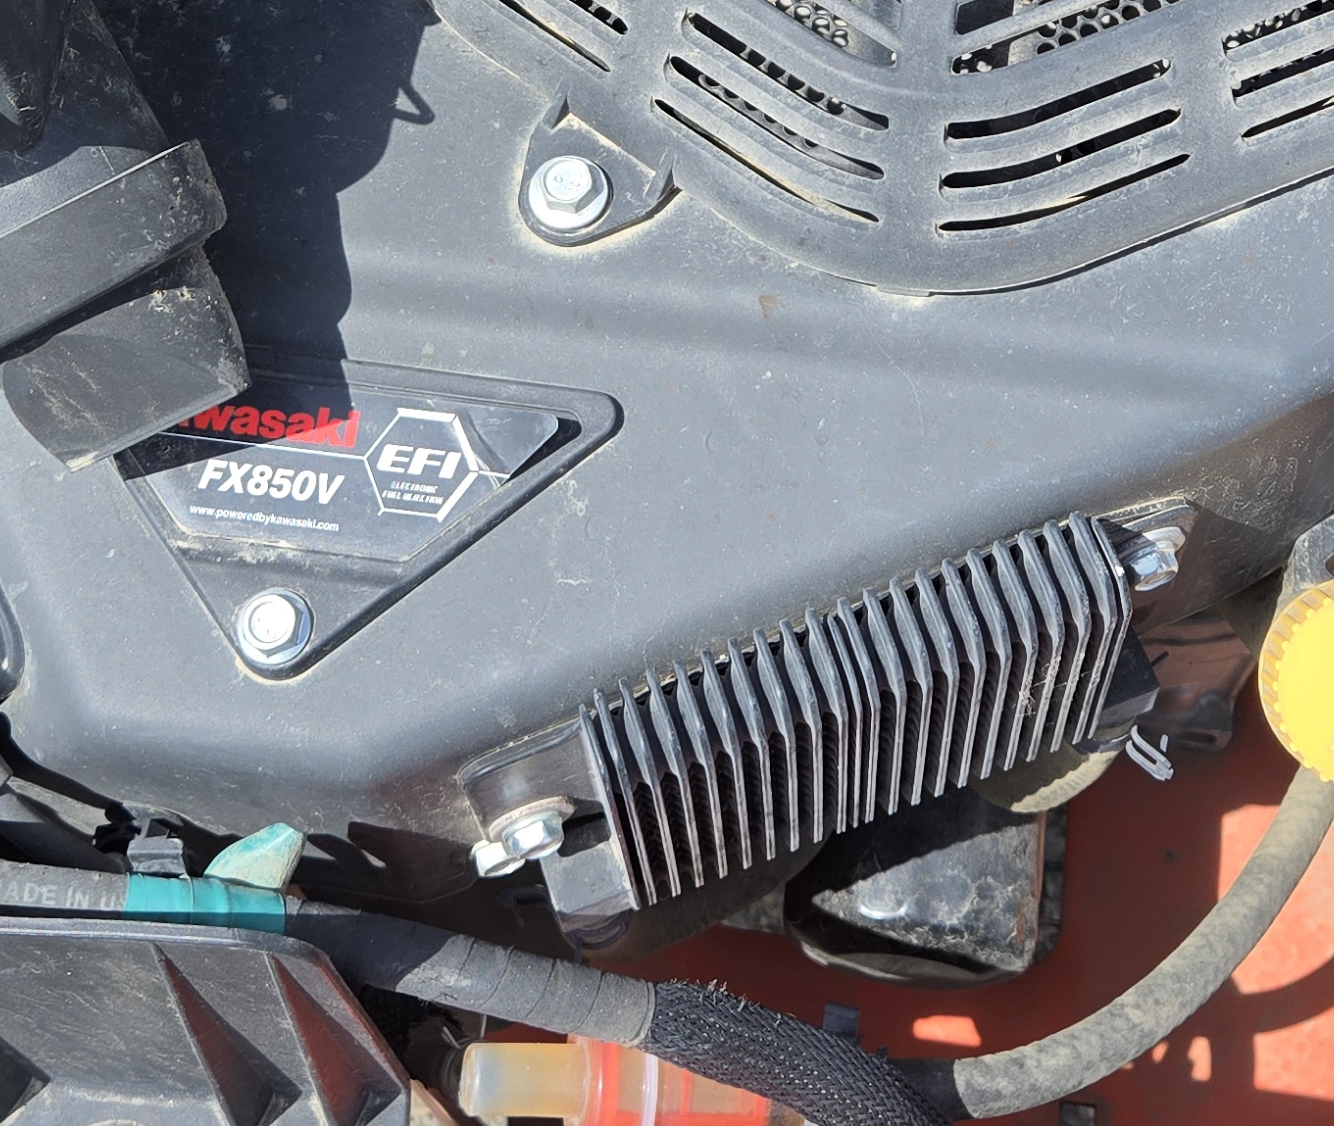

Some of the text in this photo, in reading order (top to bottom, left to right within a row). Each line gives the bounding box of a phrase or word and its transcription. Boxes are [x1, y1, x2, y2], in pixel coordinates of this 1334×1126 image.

[178, 404, 362, 449] wasaki
[376, 443, 462, 480] EFI
[198, 458, 345, 505] FX850V
[390, 480, 439, 494] ELECTRONIC
[189, 504, 340, 532] www.poweredbykawasaki.com
[65, 886, 90, 909] IN
